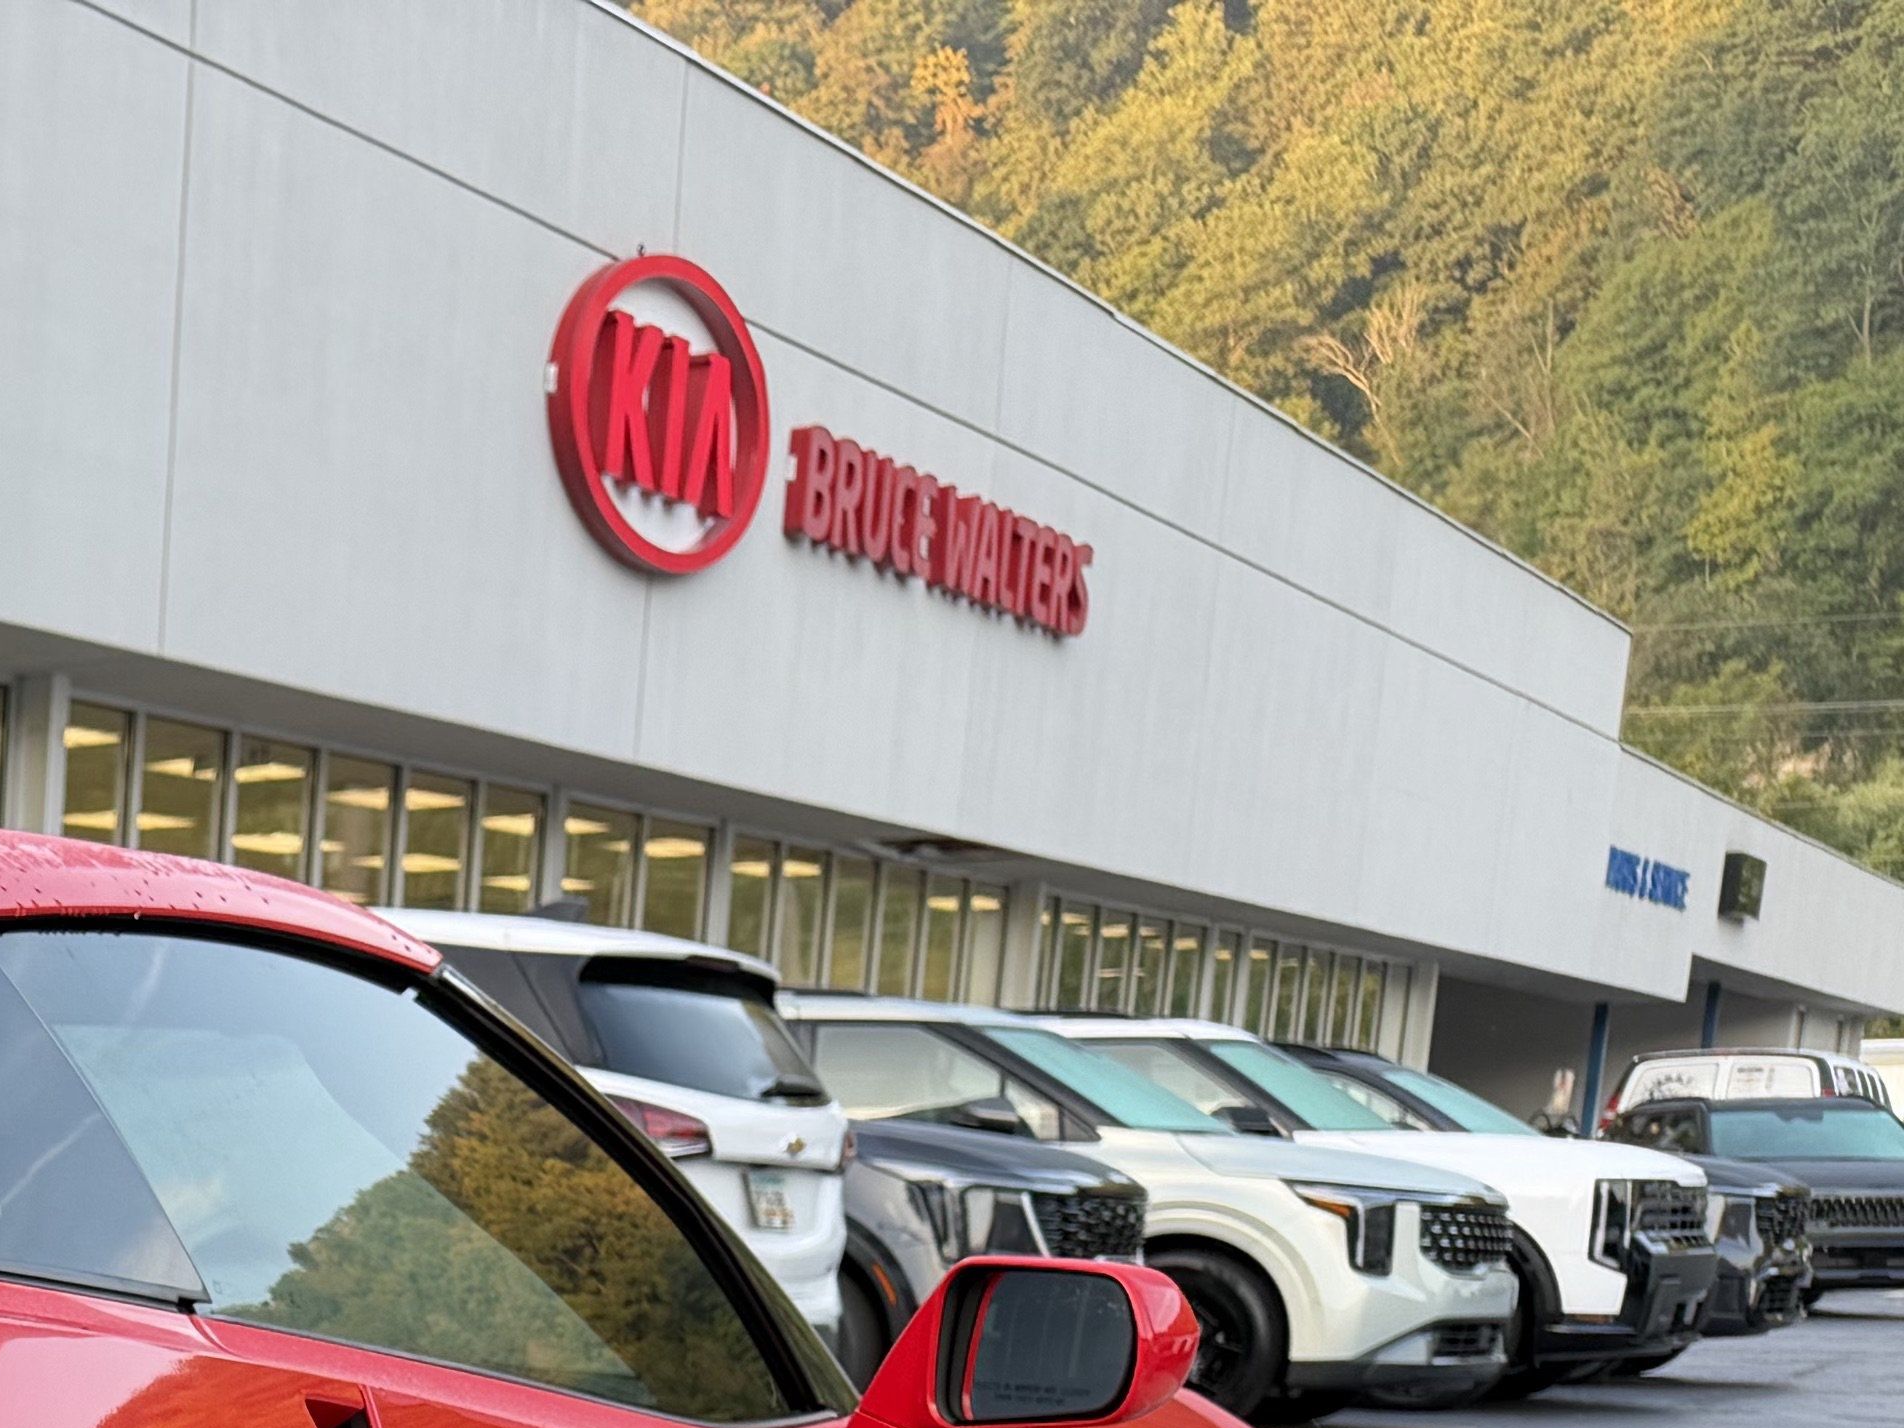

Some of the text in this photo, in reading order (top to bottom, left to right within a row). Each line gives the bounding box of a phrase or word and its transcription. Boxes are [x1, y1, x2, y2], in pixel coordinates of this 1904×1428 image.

[602, 308, 733, 520] KIA
[786, 425, 1094, 637] BRUCE WALTERS
